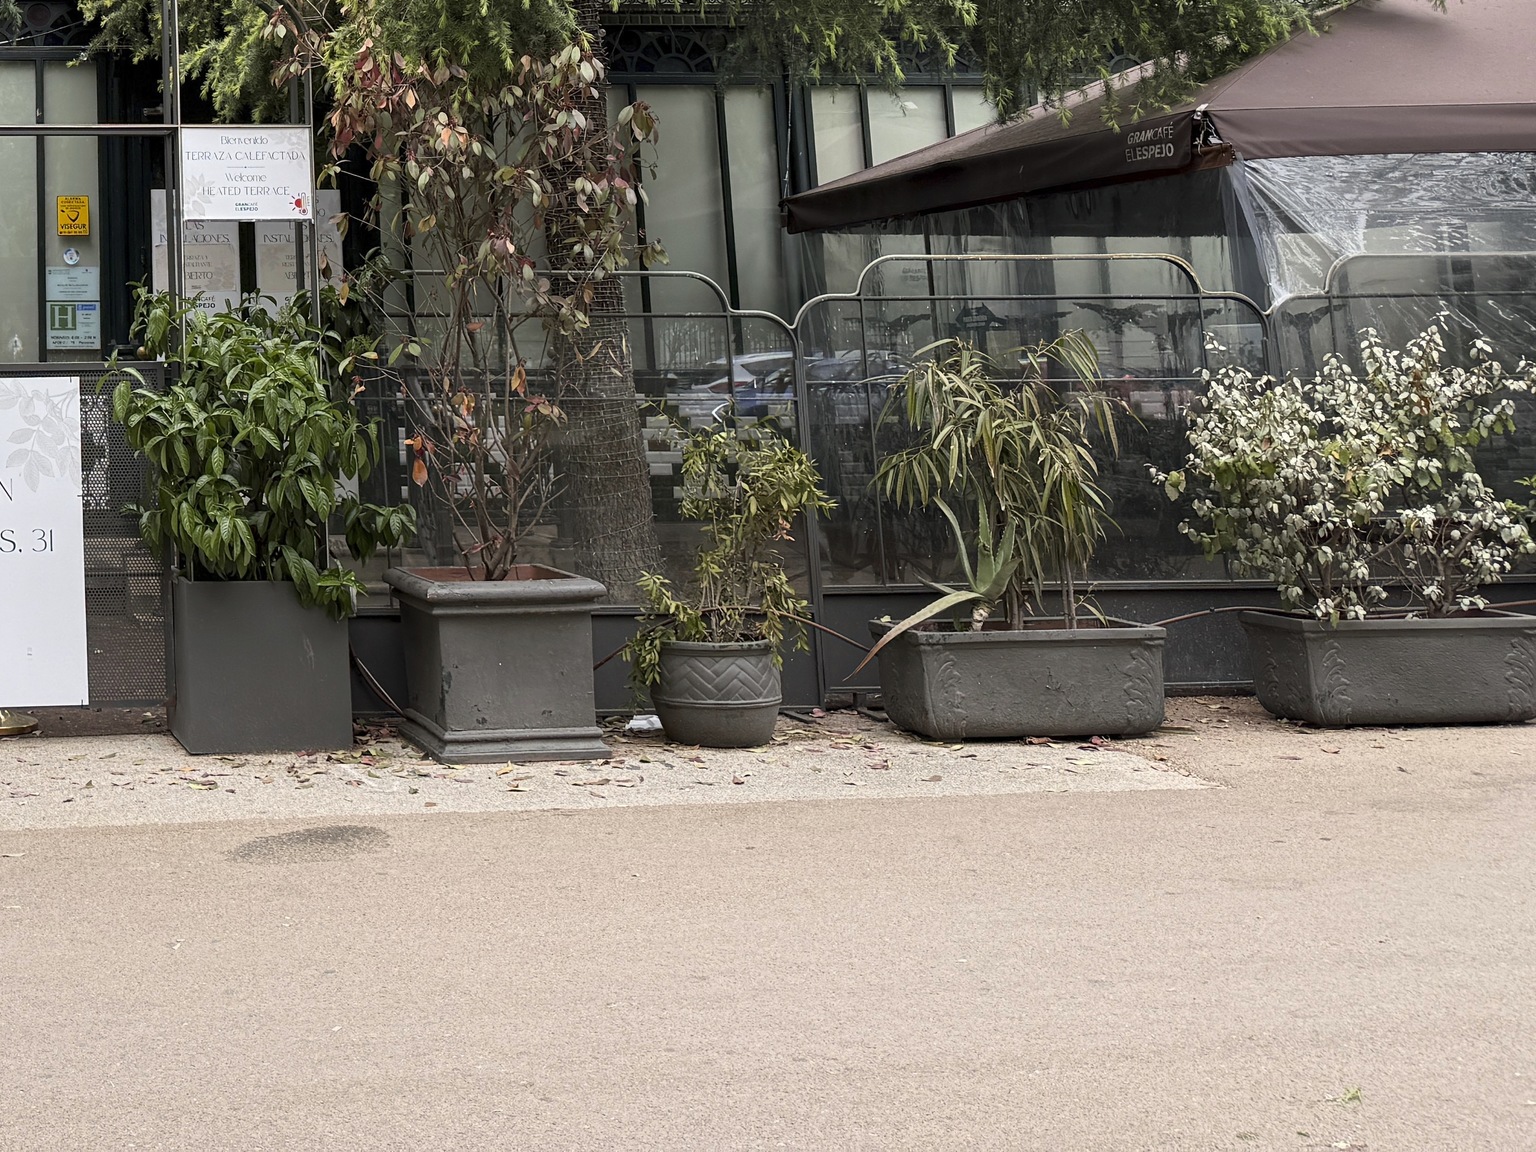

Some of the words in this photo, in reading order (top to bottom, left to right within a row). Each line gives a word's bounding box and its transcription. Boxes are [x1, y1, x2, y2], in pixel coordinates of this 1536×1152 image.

[1127, 121, 1174, 145] GRANCAFÉ
[220, 136, 268, 145] Bienvenido
[185, 151, 232, 160] TERRAZA
[235, 151, 306, 160] CALEFACTADA
[1125, 143, 1174, 162] ELESPEJO
[225, 173, 267, 182] Welcome
[202, 187, 241, 196] HEATED
[244, 186, 290, 195] TERRACE
[32, 528, 54, 552] 31
